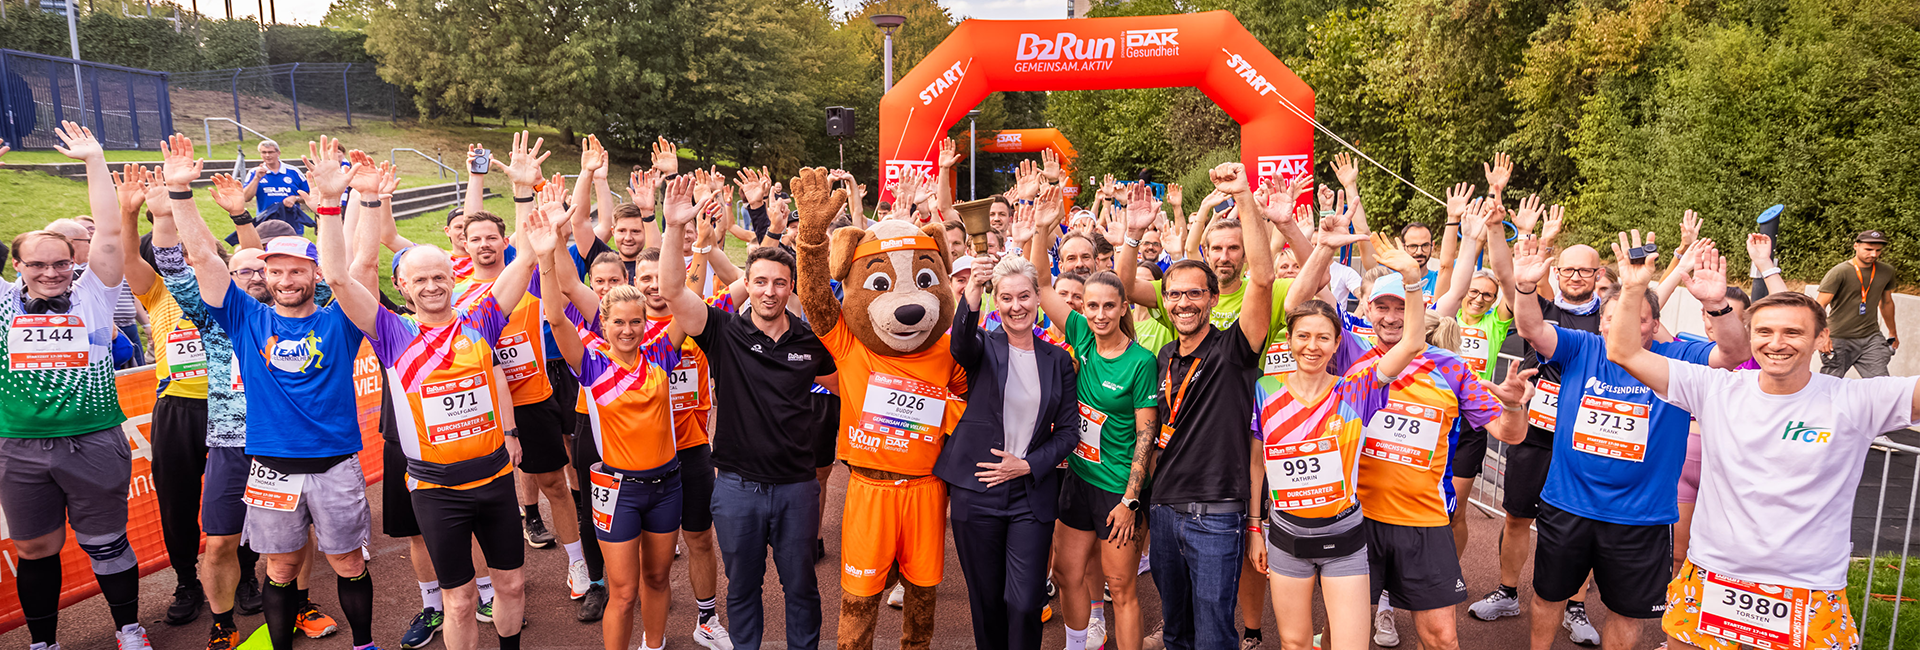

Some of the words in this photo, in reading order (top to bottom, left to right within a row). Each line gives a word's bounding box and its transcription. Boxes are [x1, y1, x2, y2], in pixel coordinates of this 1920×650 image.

[1126, 28, 1179, 47] DAK
[1016, 32, 1116, 61] B2Run
[1126, 45, 1180, 58] Gesundheit
[1014, 62, 1080, 73] GEMEINSAM.
[1081, 60, 1113, 71] AKTIV
[919, 60, 964, 105] START
[1226, 54, 1277, 96] START
[1258, 154, 1308, 176] DAK
[23, 329, 73, 342] 2144
[443, 391, 478, 411] 971
[887, 392, 925, 411] 2026
[447, 406, 478, 417] WOLFGANG
[896, 407, 913, 415] BUDDY
[436, 418, 479, 433] DURCHSTARTER
[873, 416, 900, 426] GEMEINSAM
[900, 420, 910, 428] FÜR
[910, 422, 929, 432] VIELFALT
[1384, 415, 1420, 434] 978
[1587, 411, 1635, 432] 3713
[1599, 427, 1619, 435] FRANK
[1782, 421, 1831, 443] HCR
[885, 436, 909, 448] DAK
[1375, 441, 1421, 456] DURCHSTARTER
[1283, 457, 1321, 476] 993
[1291, 474, 1318, 483] KATHRIN
[1286, 486, 1333, 497] DURCHSTARTER
[1722, 589, 1788, 618] 3980
[1736, 609, 1770, 623] TORSTEN
[1793, 598, 1804, 648] DURCHSTARTER
[1723, 621, 1751, 631] STARTZEIT
